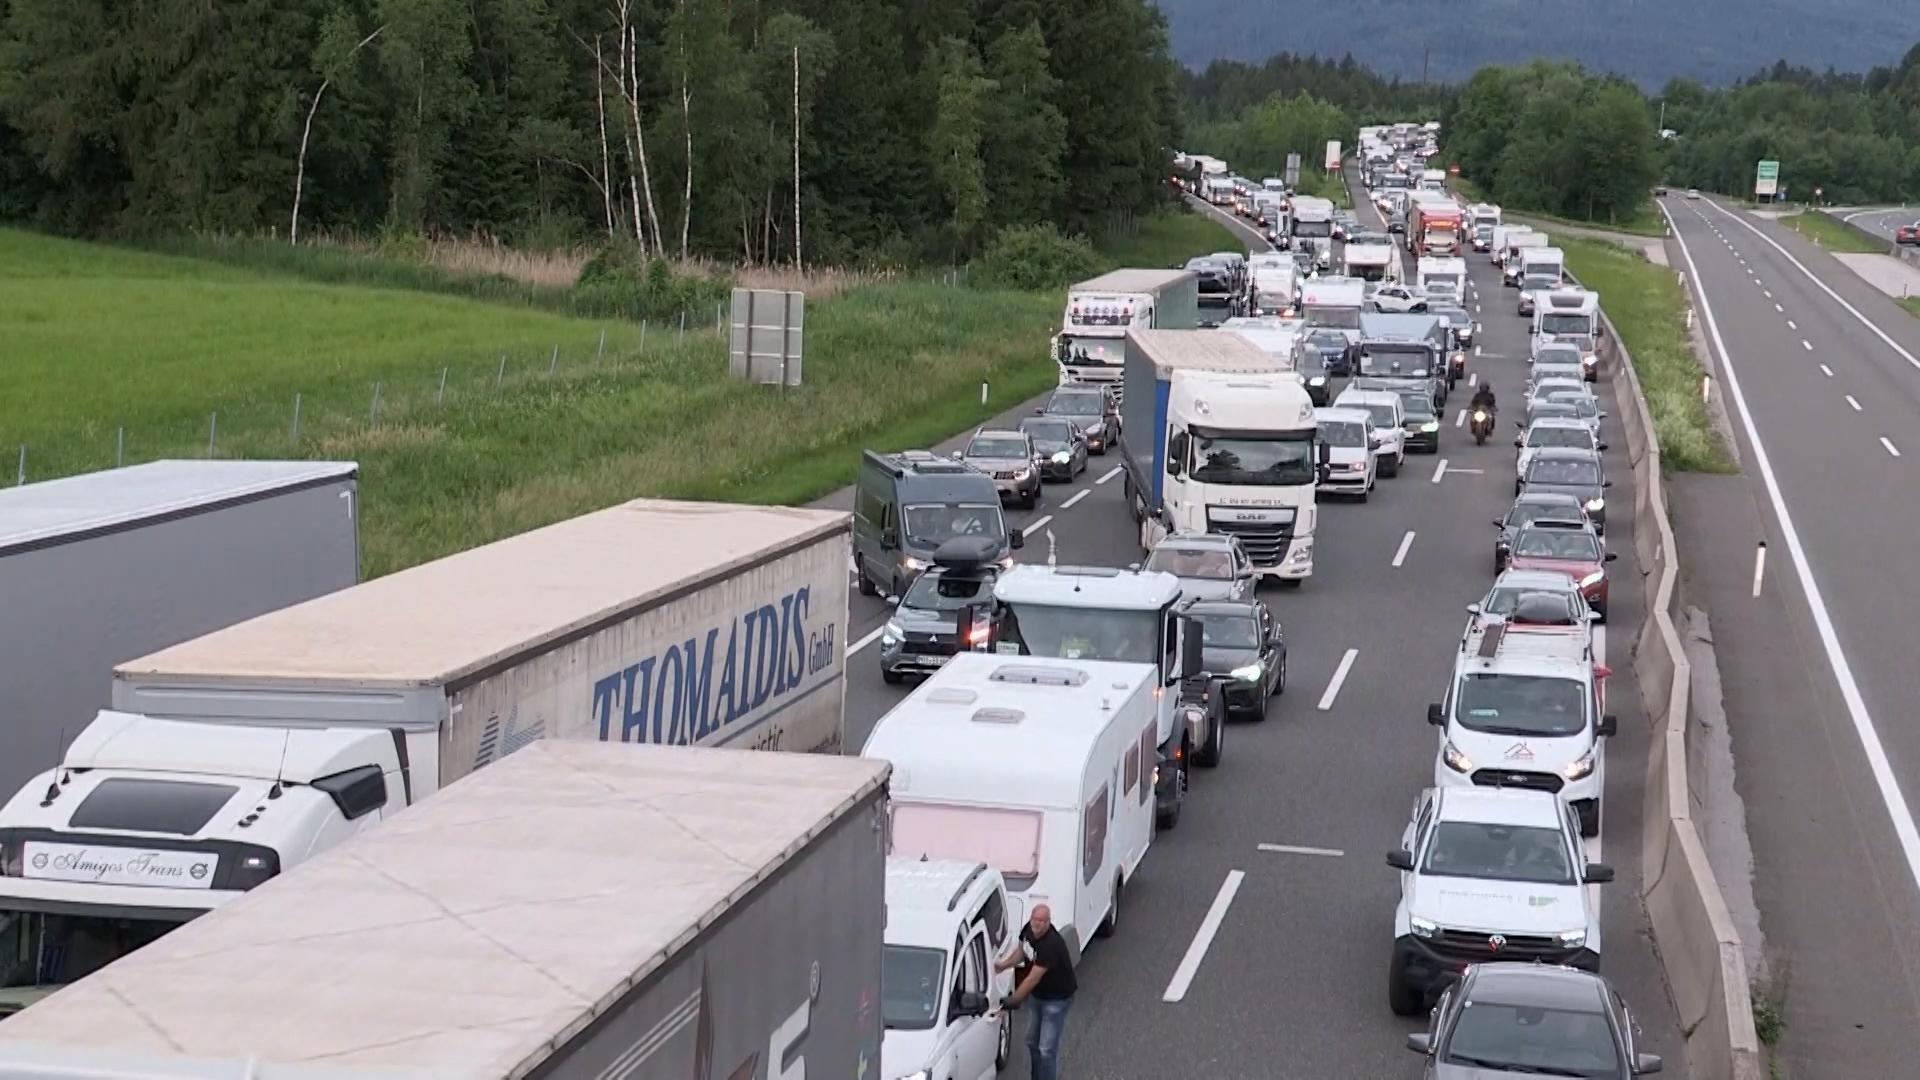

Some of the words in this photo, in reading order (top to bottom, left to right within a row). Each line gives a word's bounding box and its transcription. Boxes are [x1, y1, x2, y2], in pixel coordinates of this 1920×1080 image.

[592, 584, 810, 745] THOMAIDIS
[808, 622, 835, 676] GmbH
[53, 849, 123, 879] Amigos
[127, 853, 184, 877] Trans
